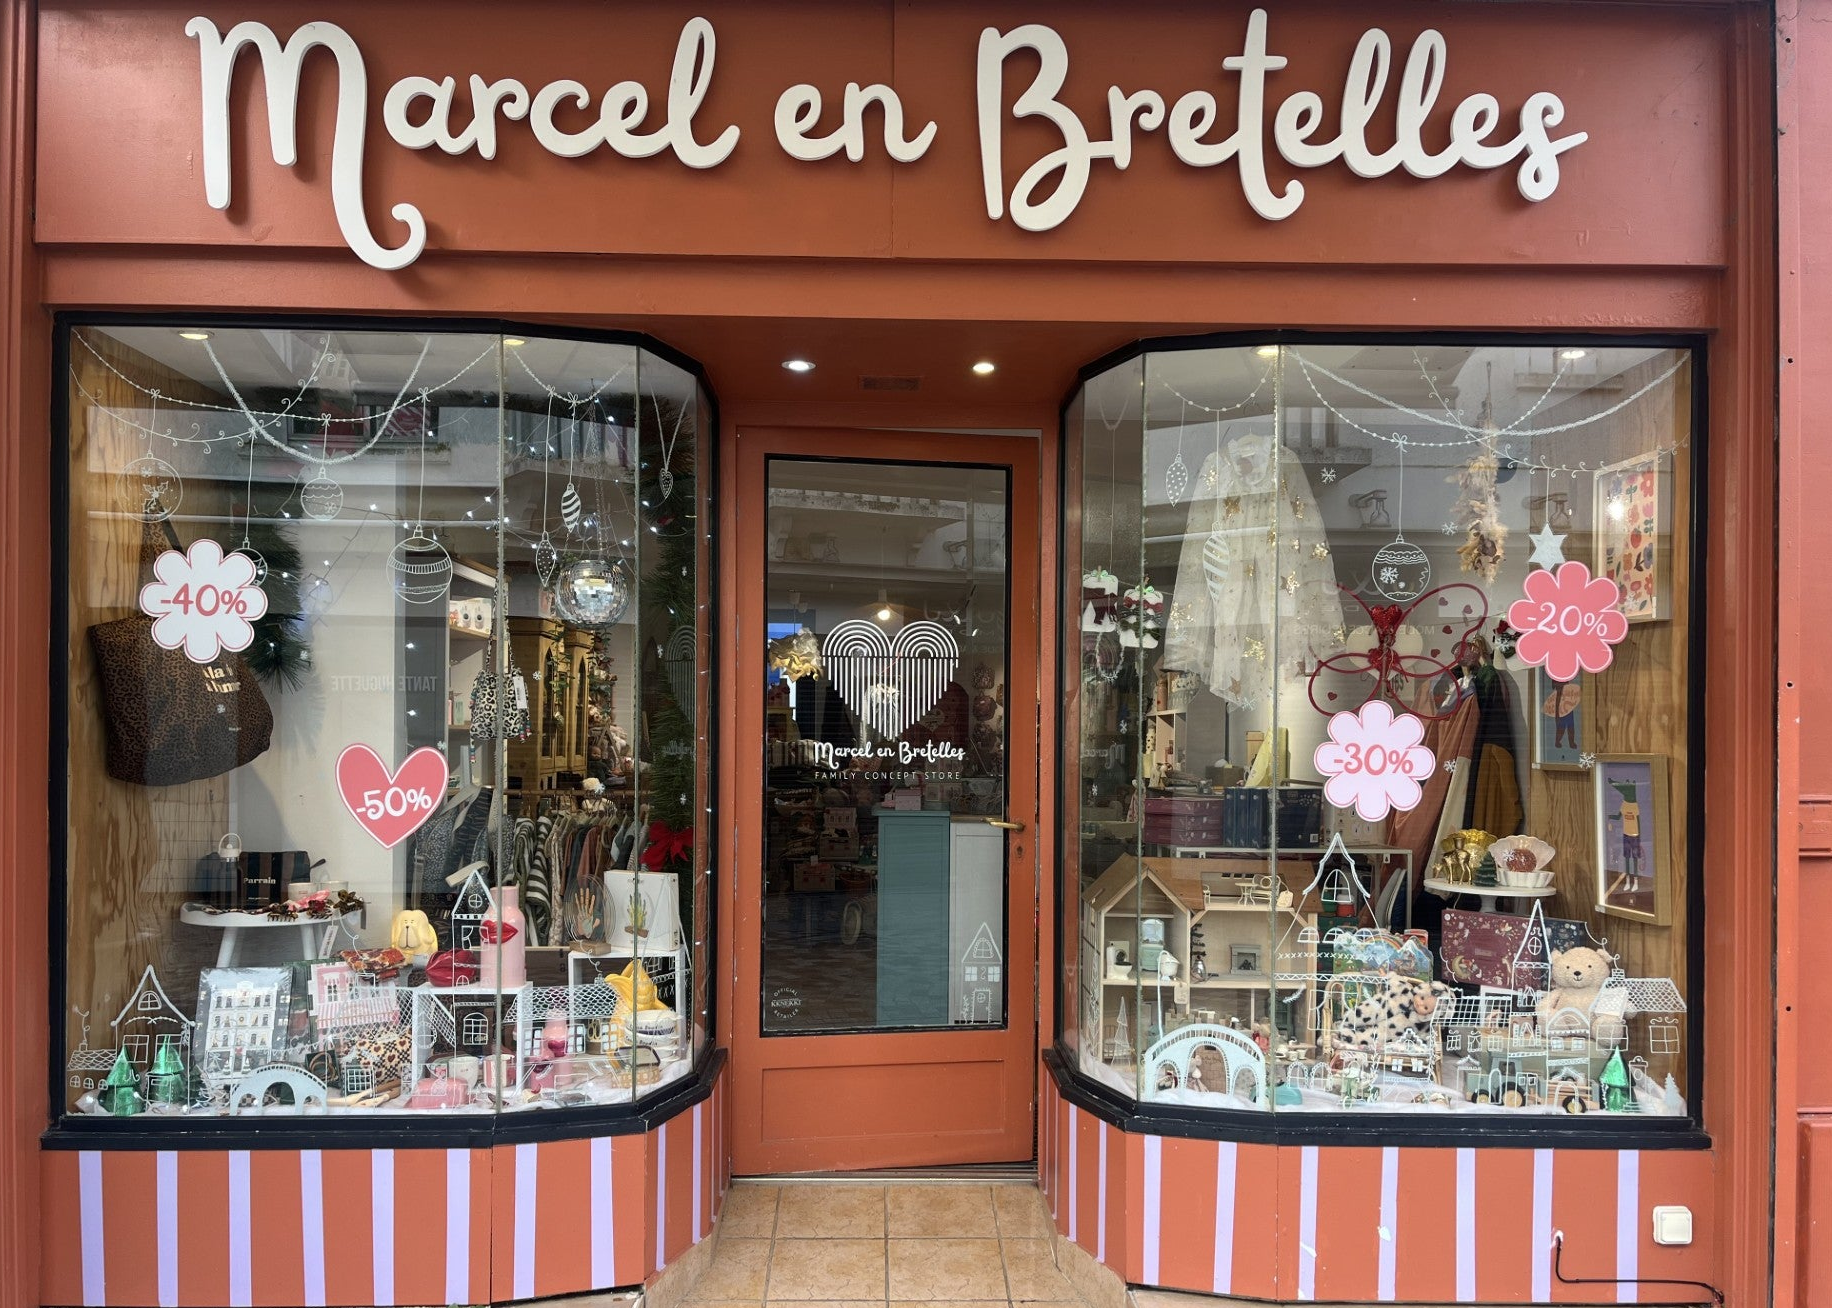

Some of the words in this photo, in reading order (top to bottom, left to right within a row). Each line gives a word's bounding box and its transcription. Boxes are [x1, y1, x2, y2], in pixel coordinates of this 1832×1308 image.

[185, 16, 740, 270] Marcel
[775, 82, 937, 162] en
[977, 9, 1588, 231] Bretelles
[160, 583, 247, 616] -40%
[1527, 602, 1607, 637] -20%
[814, 741, 873, 770] Marcel
[877, 747, 895, 758] en
[898, 739, 966, 765] Bretelles
[1334, 742, 1414, 776] -30%
[814, 771, 856, 780] FAMILY
[864, 771, 916, 780] CONCEPT
[925, 771, 960, 780] STORE
[356, 786, 432, 820] -50%
[243, 876, 276, 885] Parrain
